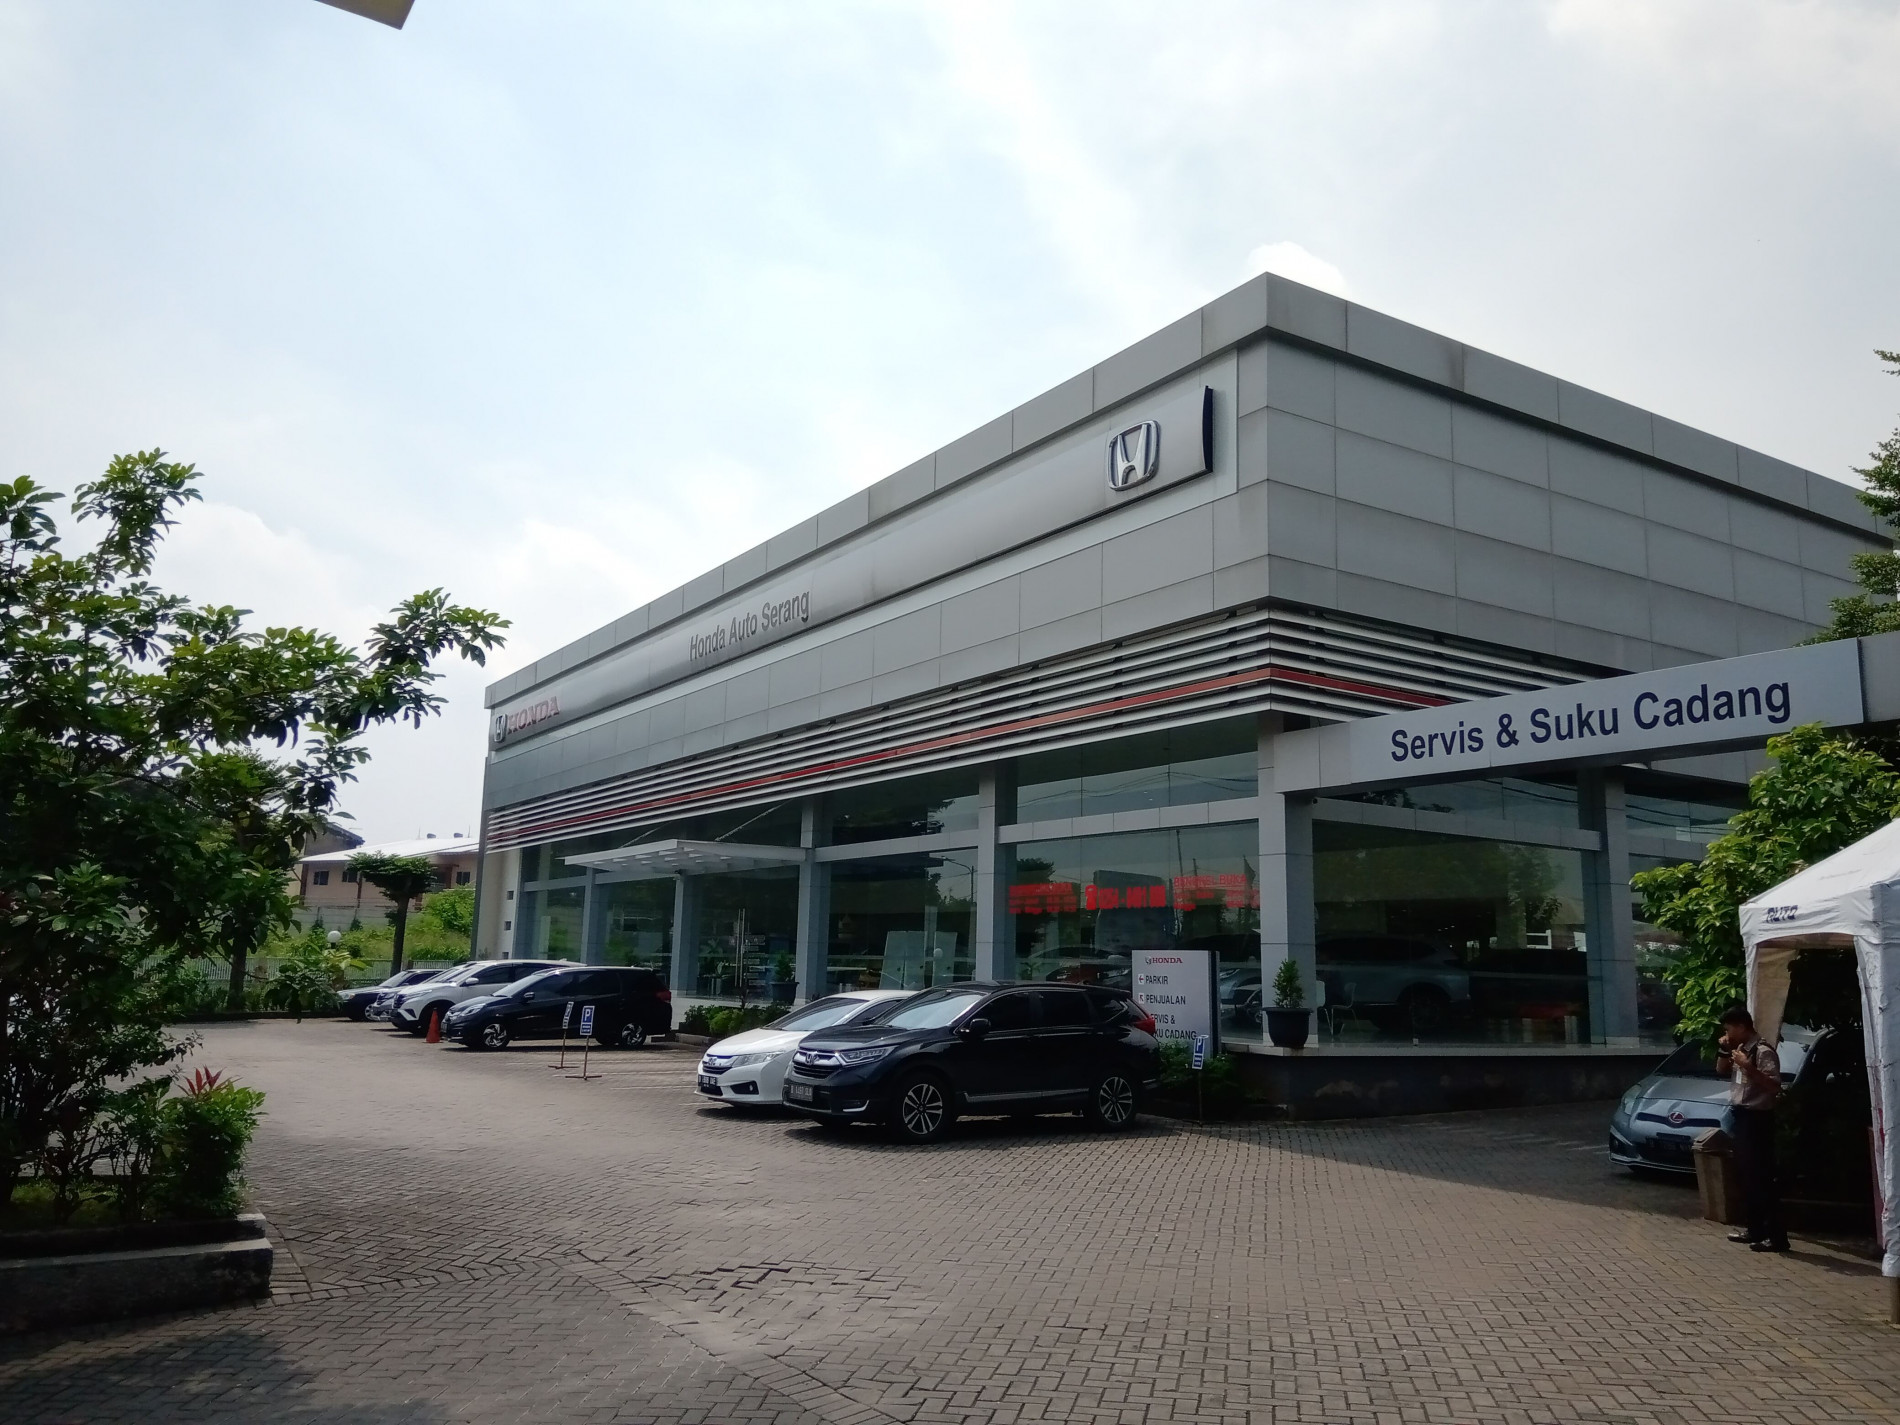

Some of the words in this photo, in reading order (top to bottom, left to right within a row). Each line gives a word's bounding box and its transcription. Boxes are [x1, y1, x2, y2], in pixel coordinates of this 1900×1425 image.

[690, 624, 725, 661] Honda
[729, 612, 758, 646] Auto
[761, 591, 810, 632] Serang
[508, 696, 559, 734] HONDA
[1391, 720, 1484, 762] Servis
[1496, 713, 1519, 749] &
[1530, 703, 1619, 743] Suku
[1633, 682, 1791, 730] Cadang
[1145, 975, 1168, 985] PARKIR
[1146, 994, 1186, 1005] PENJUALAN
[584, 1008, 591, 1021] P
[1170, 1014, 1176, 1024] &
[1165, 1028, 1197, 1040] CADANG
